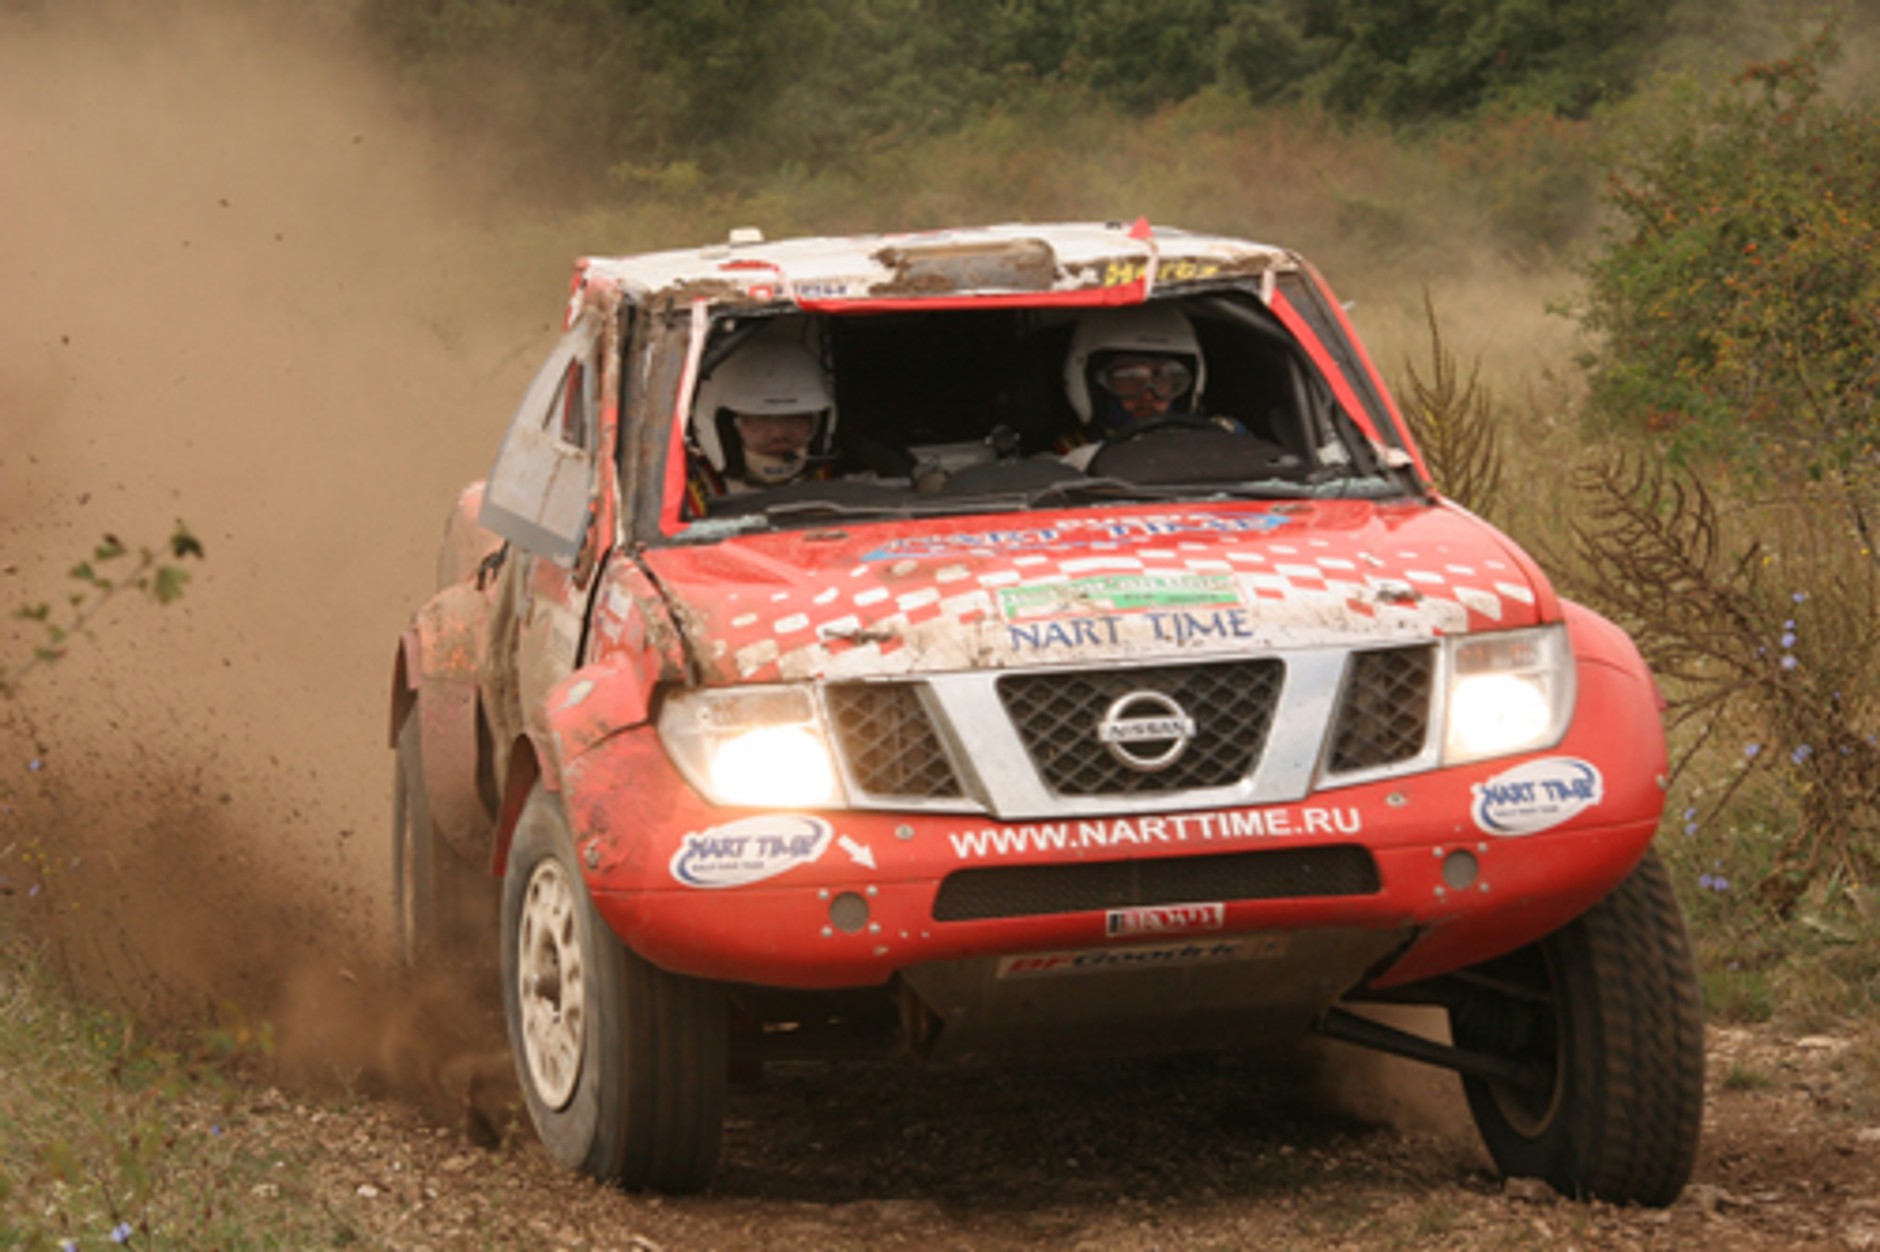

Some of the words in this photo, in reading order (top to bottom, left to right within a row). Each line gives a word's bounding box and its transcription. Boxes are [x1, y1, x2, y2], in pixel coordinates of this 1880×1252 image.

[1008, 617, 1122, 650] NART
[1144, 609, 1254, 645] TIME
[1110, 721, 1184, 739] NISSAN
[1481, 781, 1535, 805] NART
[1540, 778, 1594, 800] TIME
[948, 807, 1362, 858] WWW.NARTTIME.RU
[687, 836, 748, 859] NART
[755, 834, 812, 858] TIME
